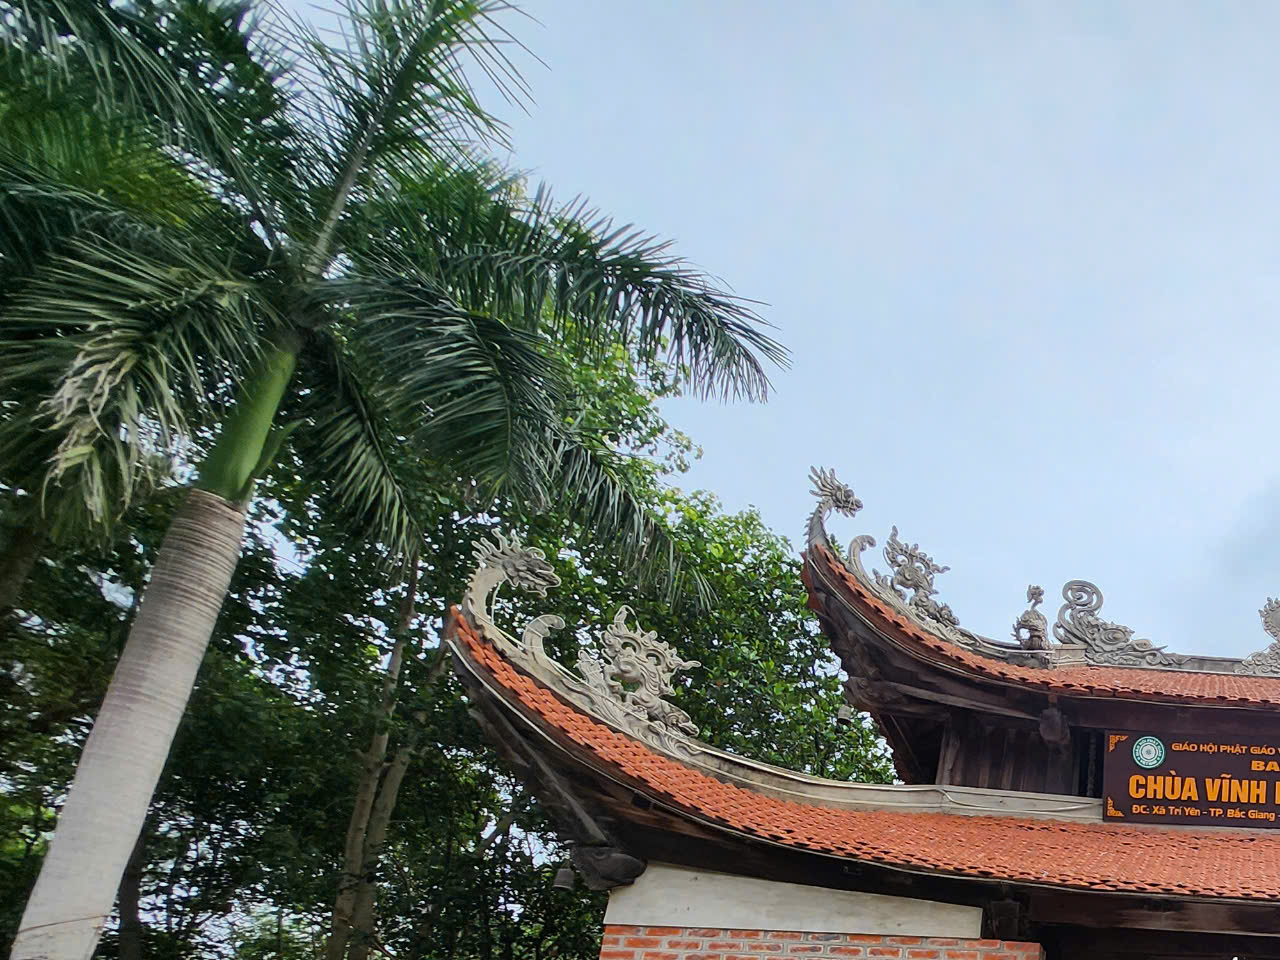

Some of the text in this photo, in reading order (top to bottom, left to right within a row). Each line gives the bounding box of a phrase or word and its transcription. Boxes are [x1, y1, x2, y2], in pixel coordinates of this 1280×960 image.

[1171, 741, 1198, 751] GIÁO
[1200, 742, 1218, 754] HỘI
[1220, 743, 1248, 755] PHẬT
[1250, 745, 1276, 755] GIÁO
[1128, 770, 1199, 801] CHÙA
[1205, 773, 1267, 804] VĨNH
[1132, 804, 1150, 815] ĐC:
[1152, 805, 1166, 815] Xã
[1168, 806, 1183, 816] Trí
[1183, 807, 1200, 817] Yên
[1209, 808, 1224, 818] TP.
[1227, 808, 1246, 819] Bắc
[1248, 810, 1275, 822] Giang
